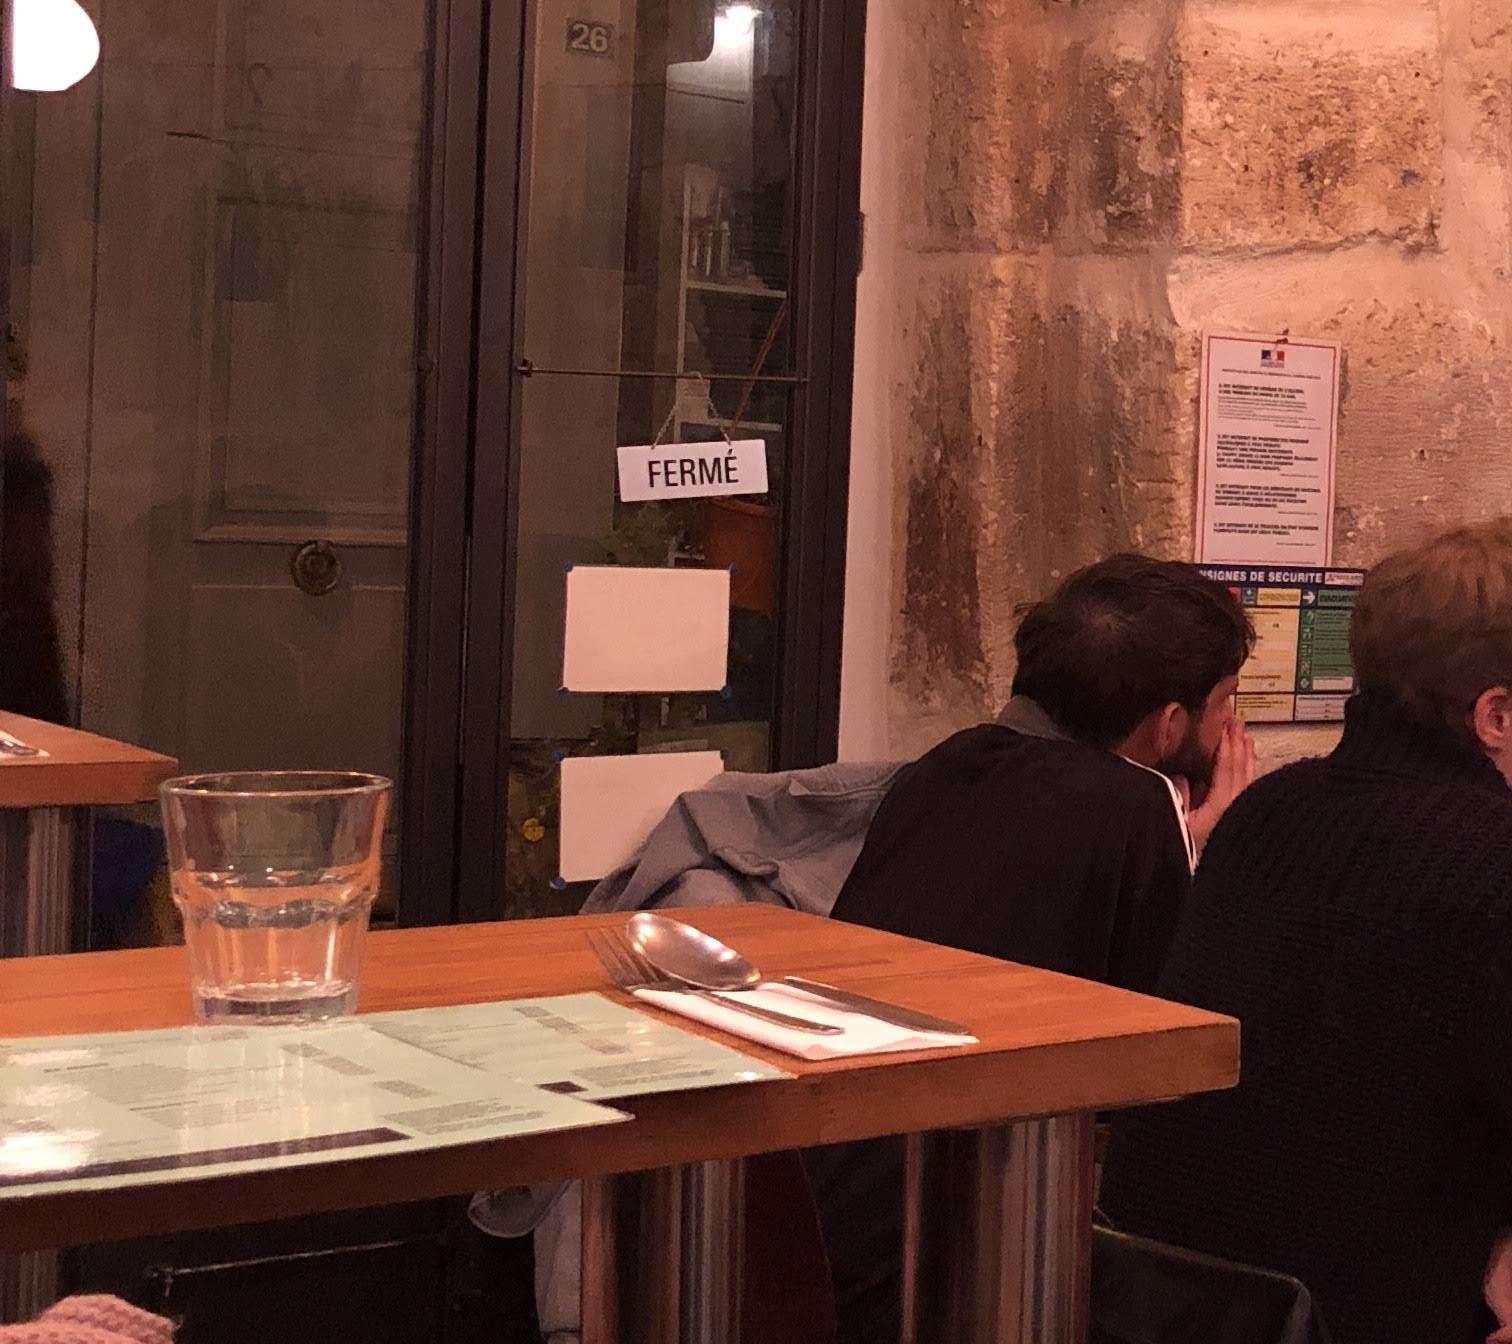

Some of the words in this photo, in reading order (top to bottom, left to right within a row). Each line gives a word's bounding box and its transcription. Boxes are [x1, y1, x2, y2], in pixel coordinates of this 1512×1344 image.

[571, 22, 608, 52] 26
[647, 447, 740, 488] FERMÉ
[1250, 570, 1265, 583] DE
